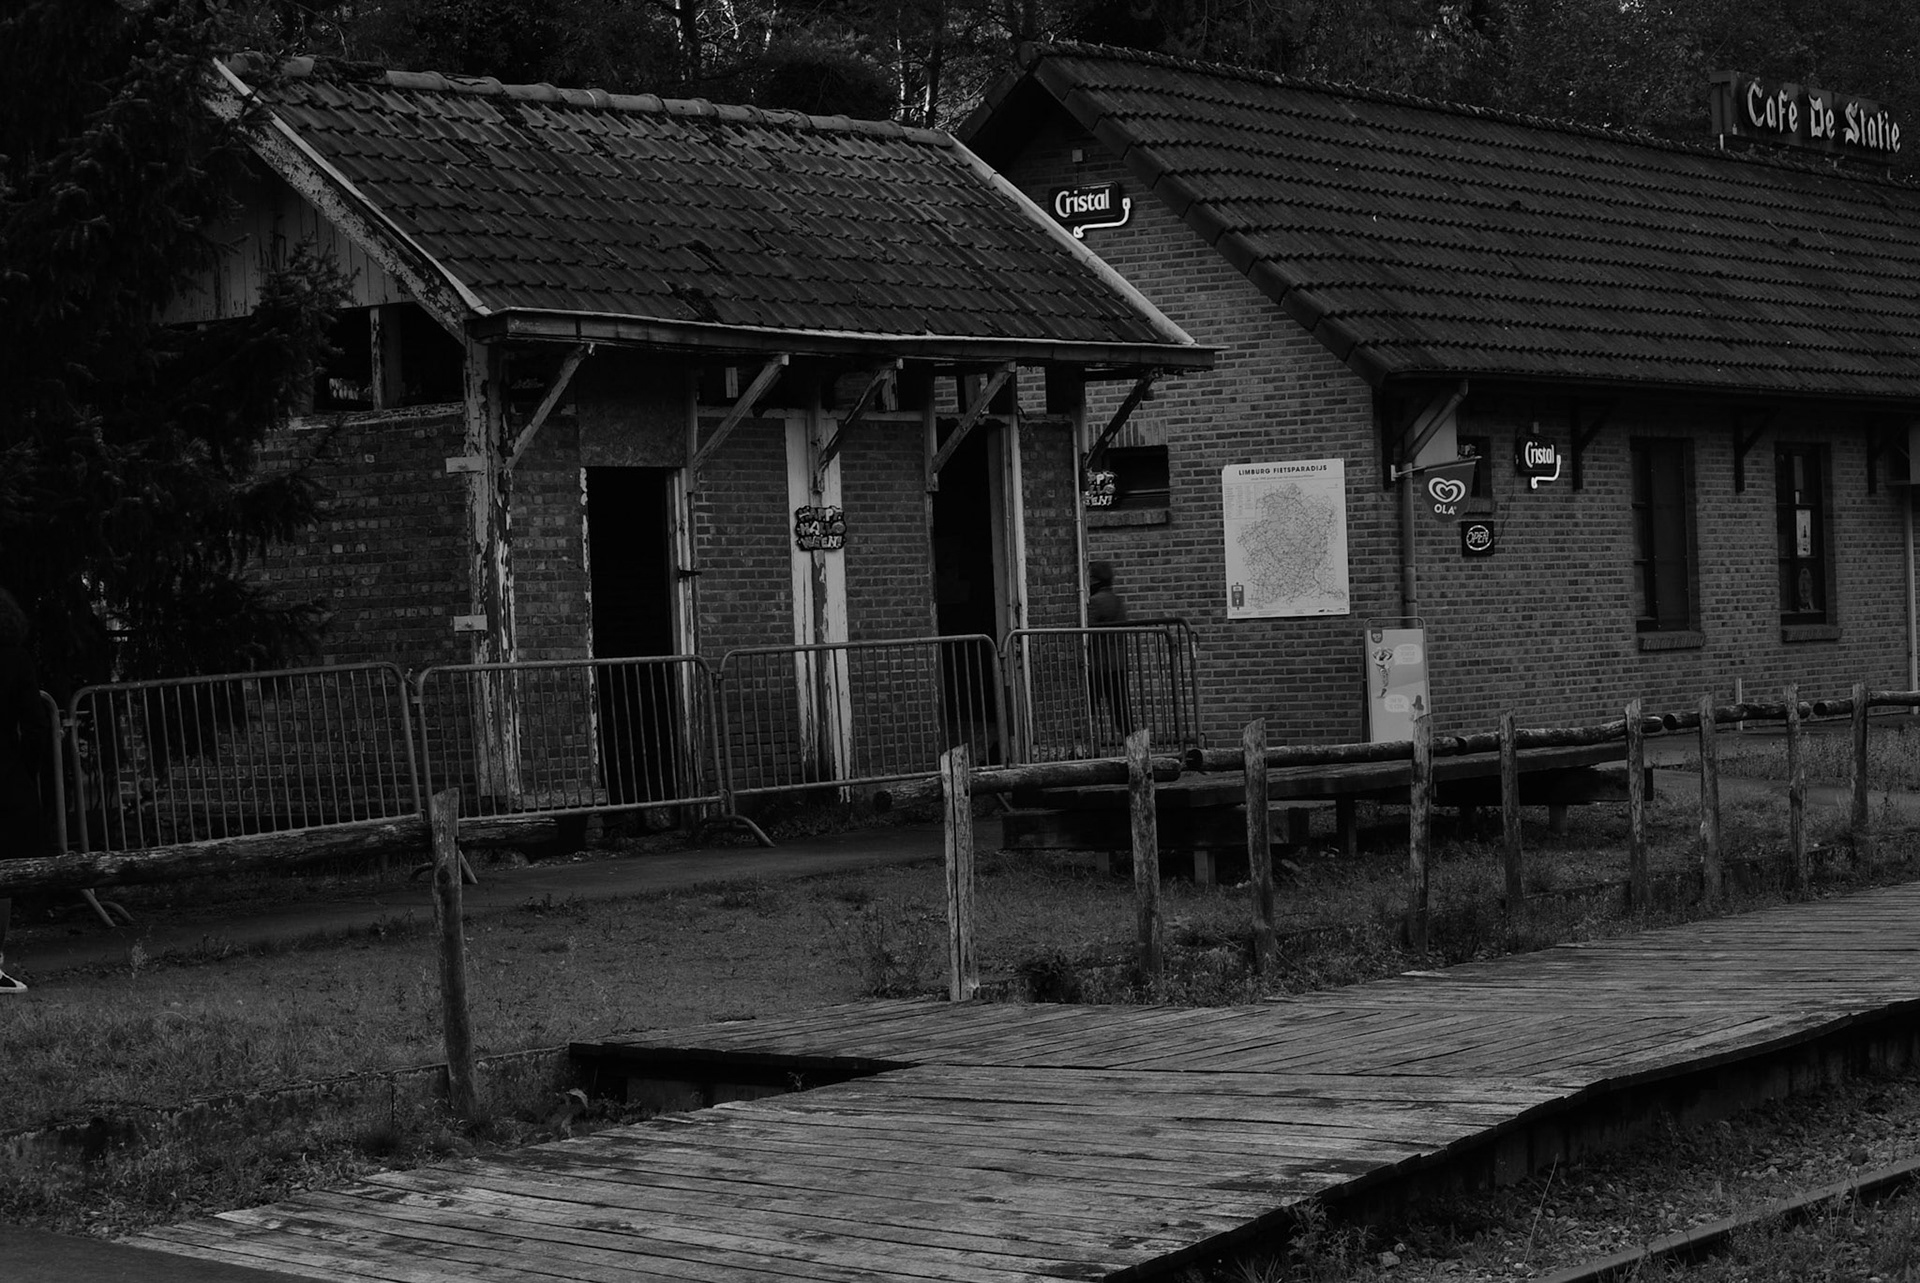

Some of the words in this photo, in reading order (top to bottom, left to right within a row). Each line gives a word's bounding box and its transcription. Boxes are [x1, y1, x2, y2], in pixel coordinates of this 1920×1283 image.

[1808, 93, 1836, 140] De
[1842, 101, 1901, 153] Statie
[1055, 189, 1110, 218] Cristal
[1524, 440, 1555, 468] Cristal
[1238, 467, 1271, 476] LIMBURG
[1273, 465, 1328, 474] FIETSPARADIJS
[1433, 504, 1455, 516] OLA
[1467, 531, 1490, 544] OPEN
